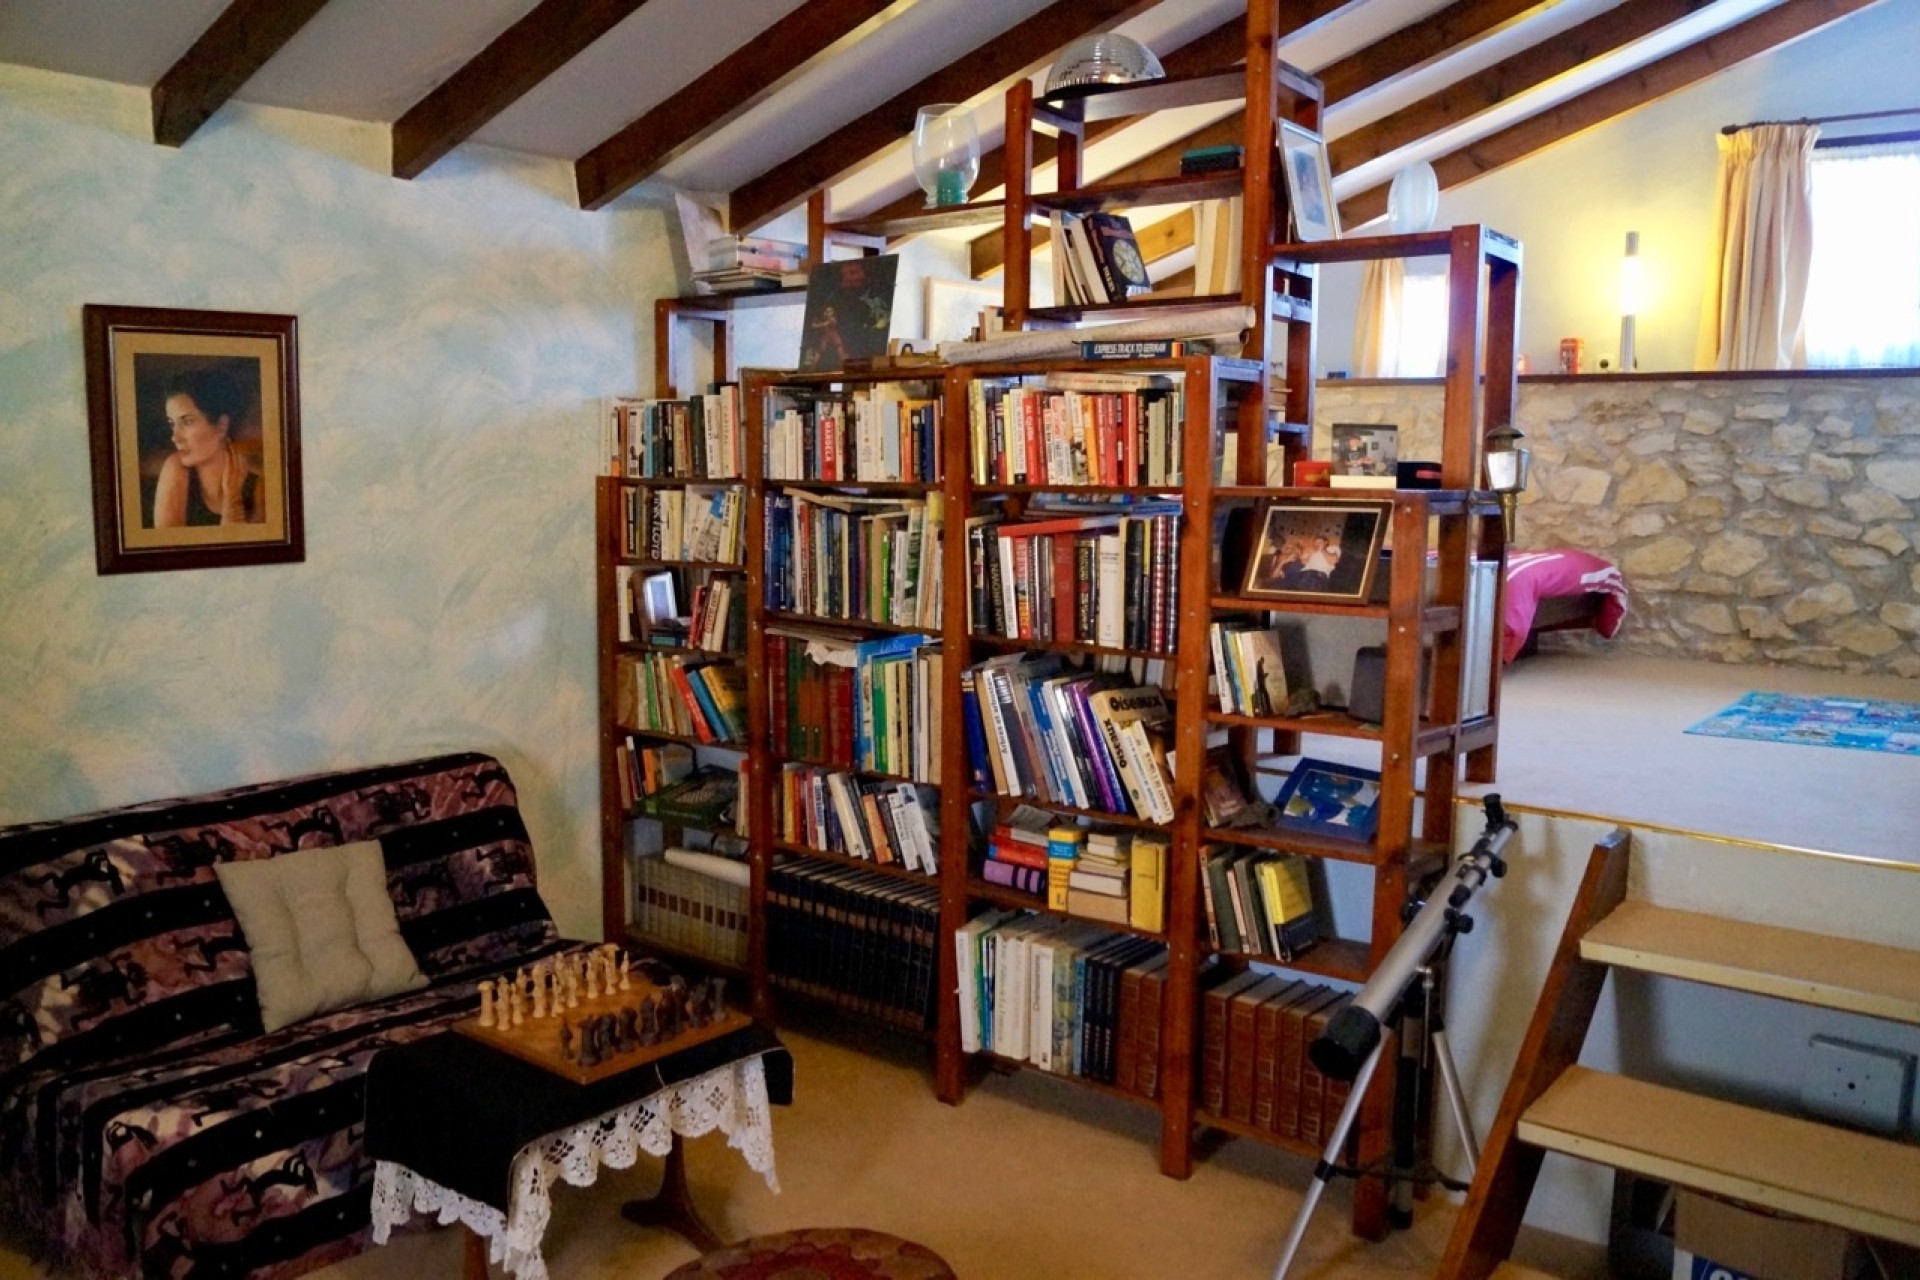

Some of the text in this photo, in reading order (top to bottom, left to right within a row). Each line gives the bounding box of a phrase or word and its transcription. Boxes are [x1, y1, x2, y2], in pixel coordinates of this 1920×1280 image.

[1094, 343, 1166, 354] EXPRESS TRACK TO GERMAN
[824, 421, 834, 462] MANDELA
[991, 562, 1003, 612] BROWN
[1108, 694, 1162, 712] Oiseaux
[996, 726, 1008, 754] Arbres
[1104, 718, 1128, 769] Oiseaux
